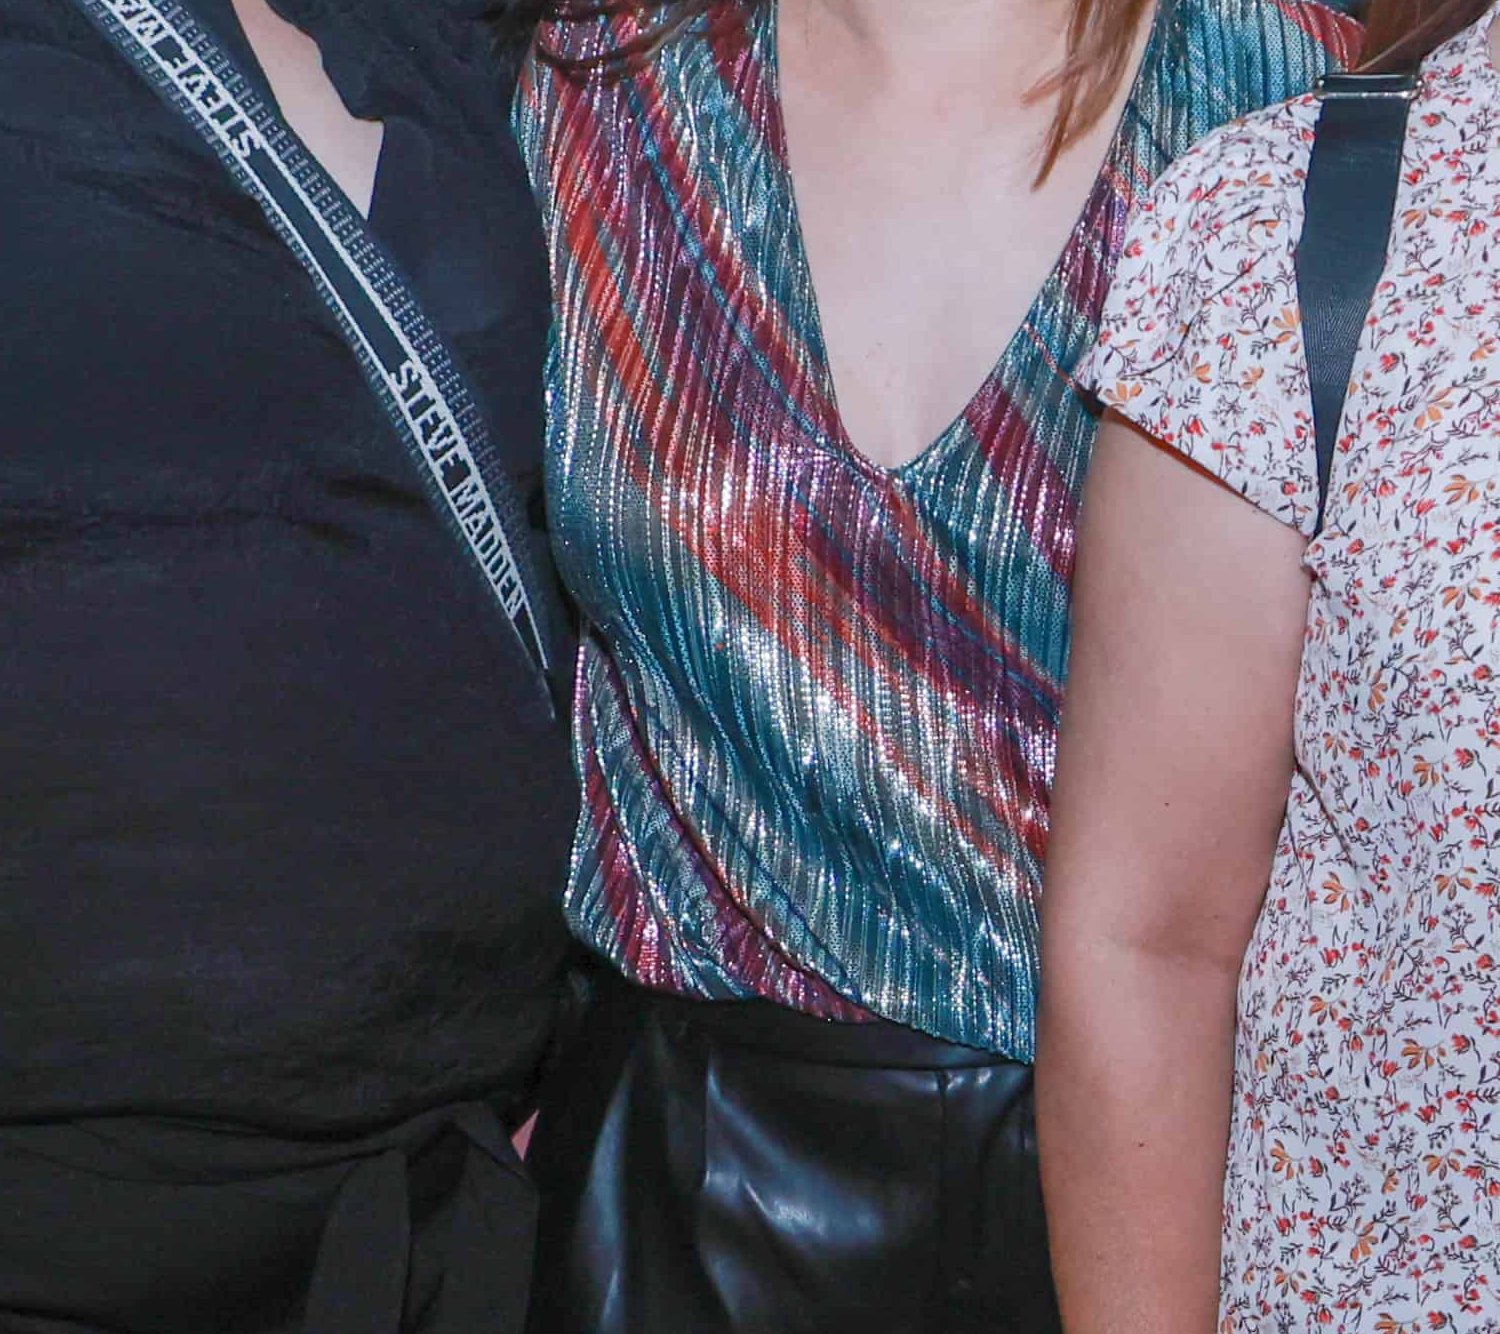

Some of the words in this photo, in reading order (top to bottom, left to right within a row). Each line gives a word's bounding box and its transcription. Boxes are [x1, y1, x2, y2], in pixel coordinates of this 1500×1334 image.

[162, 48, 263, 158] STEVE
[388, 359, 471, 476] STEVE
[449, 479, 526, 619] MADDEN
